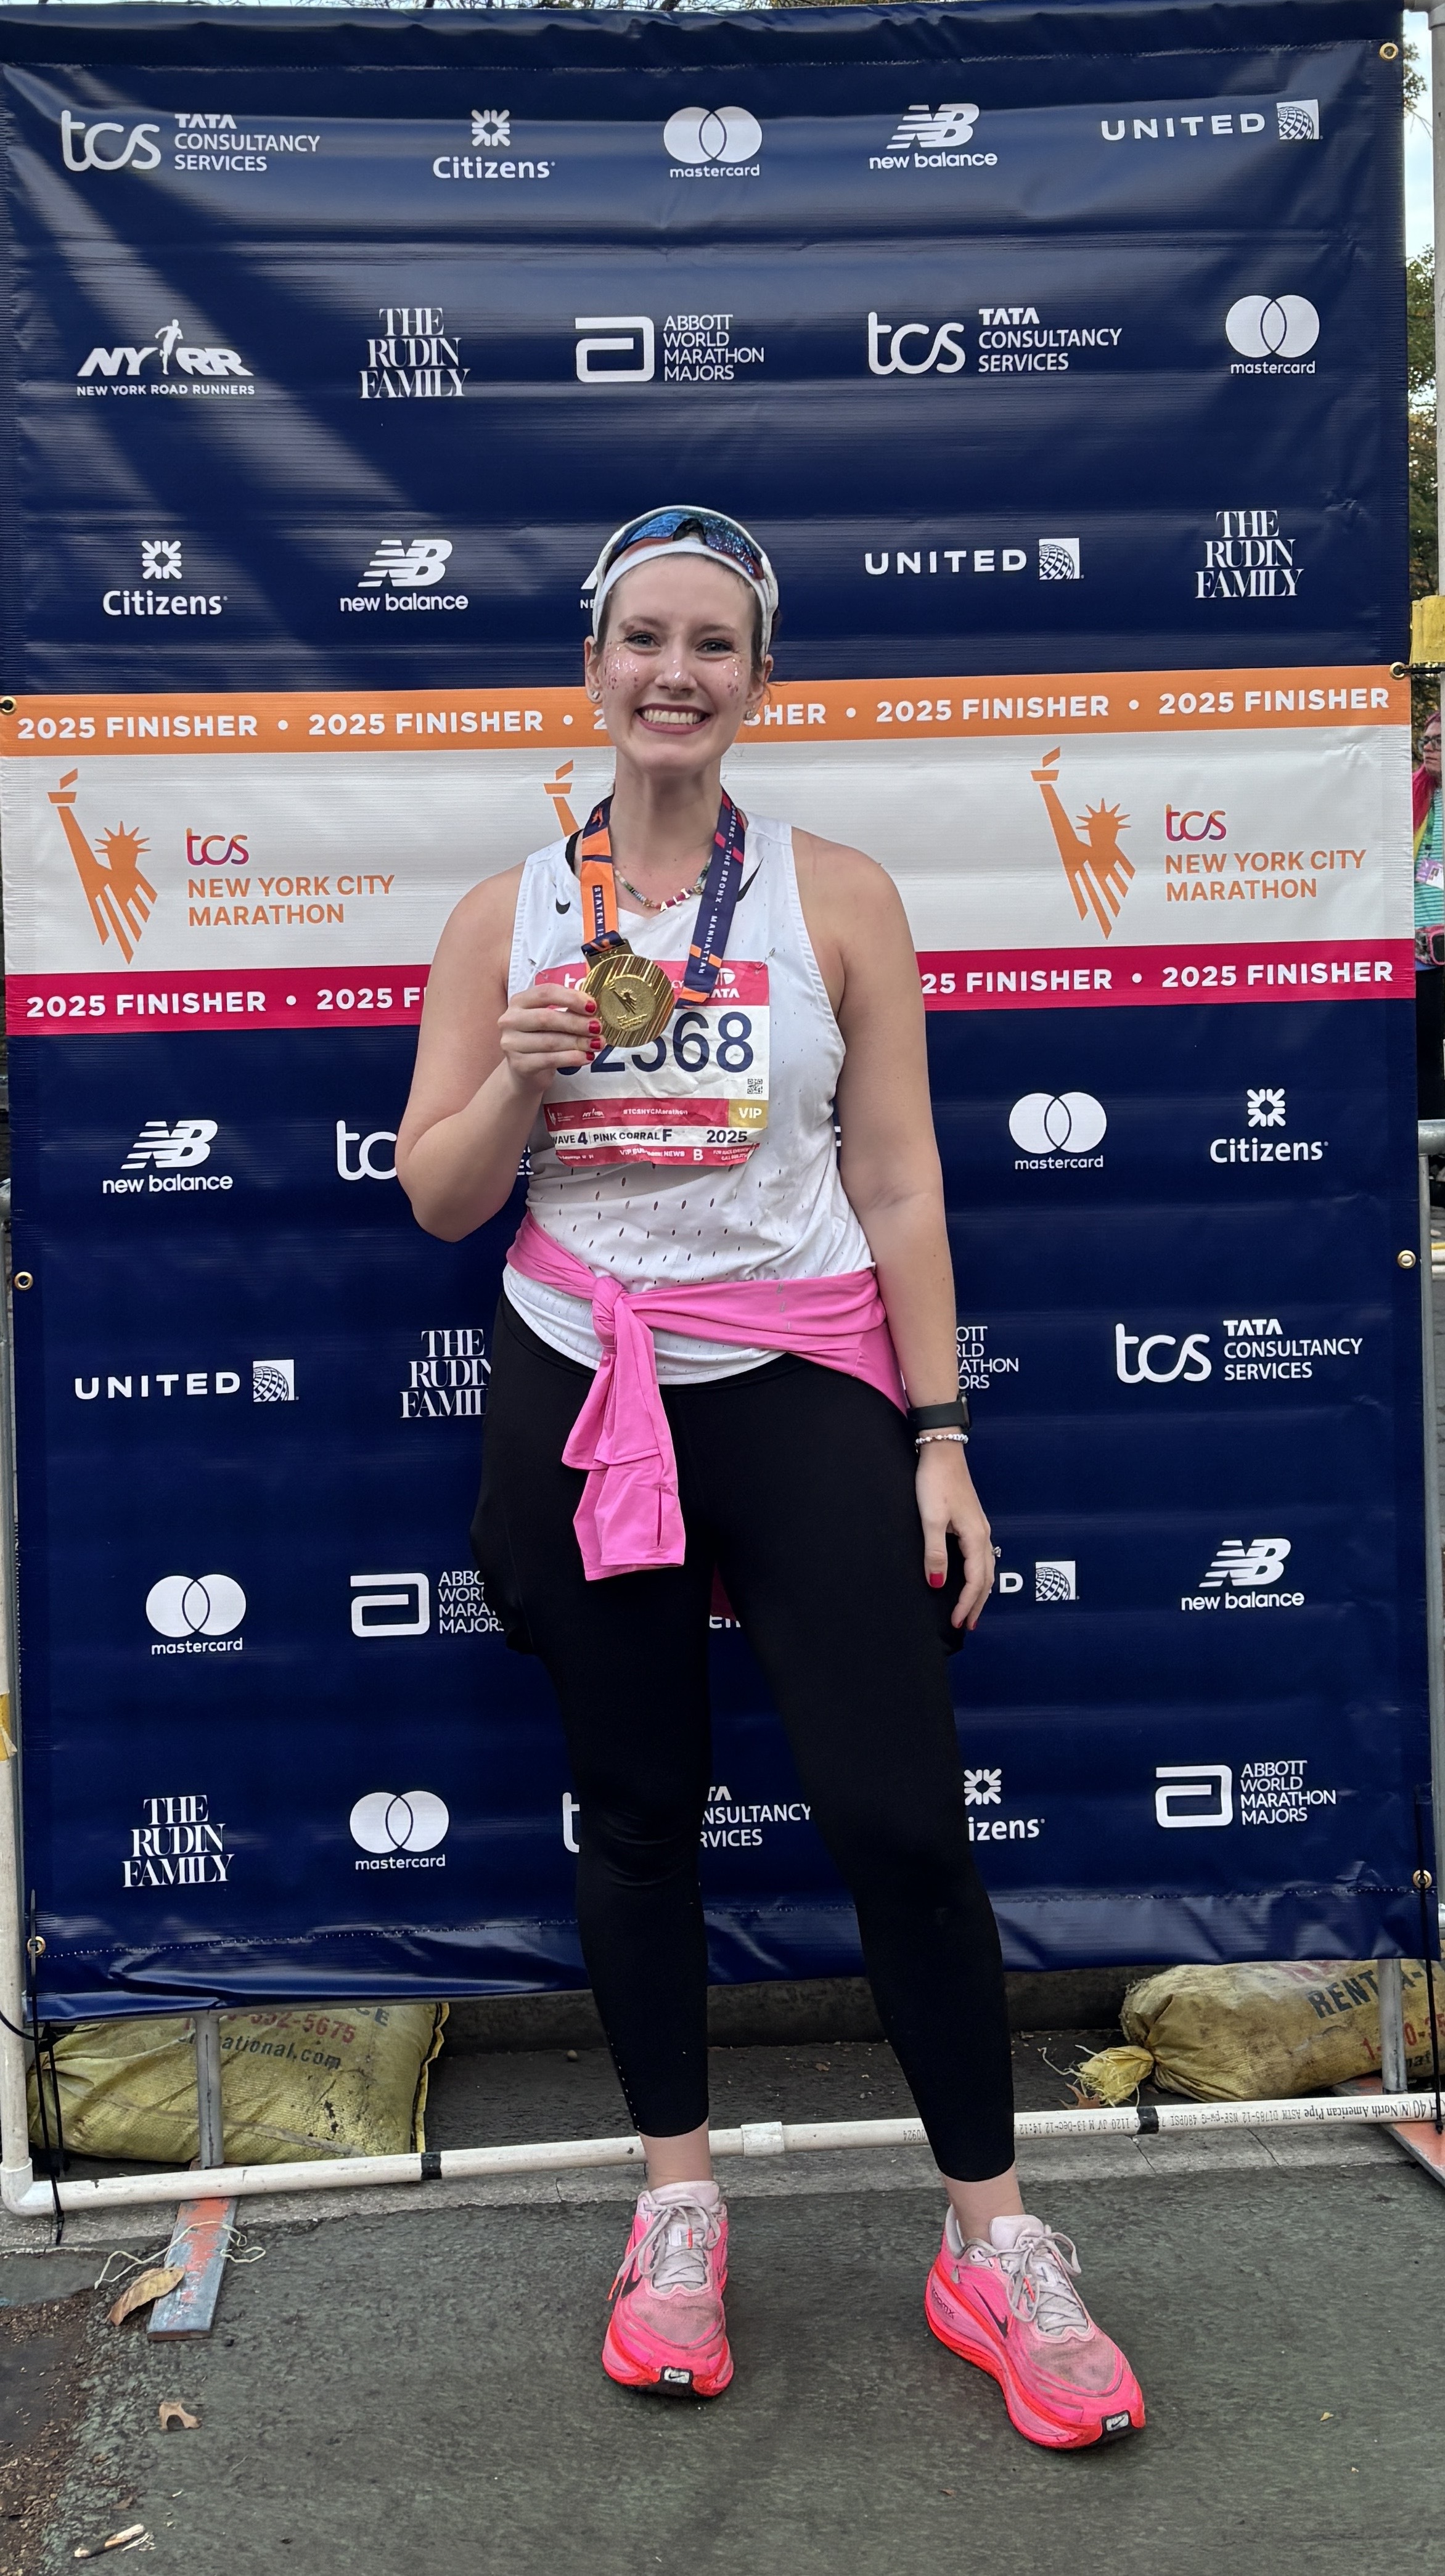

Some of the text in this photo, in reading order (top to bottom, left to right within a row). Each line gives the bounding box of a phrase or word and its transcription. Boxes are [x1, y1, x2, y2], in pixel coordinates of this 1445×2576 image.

[174, 114, 237, 129] TATA
[1102, 113, 1264, 140] UNITED
[62, 110, 161, 171] tcs
[174, 133, 320, 152] CONSULTANCY
[174, 155, 267, 171] SERVICES
[433, 157, 549, 178] Citizens
[869, 152, 997, 169] new balance
[670, 164, 759, 178] mastercard
[380, 308, 443, 336] THE
[664, 314, 733, 331] ABBOTT
[979, 308, 1039, 325] TATA
[663, 332, 729, 347] WORLD
[868, 312, 965, 374] tcs
[979, 329, 1122, 349] CONSULTANCY
[368, 338, 461, 367] RUDIN
[665, 348, 764, 364] MARATHON
[978, 353, 1068, 372] SERVICES
[1230, 361, 1315, 374] mastercard
[665, 365, 734, 381] MAJORS
[77, 385, 255, 396] NEW YORK ROAD RUNNERS
[361, 369, 470, 398] FAMILY
[1216, 510, 1279, 538] THE
[865, 550, 1026, 574] UNITED
[1205, 539, 1295, 568] RUDIN
[1196, 569, 1304, 598] FAMILY
[104, 591, 221, 615] Citizens
[340, 593, 468, 611] new balance
[877, 700, 951, 722] 2025
[964, 696, 1108, 719] FINISHER
[1159, 692, 1234, 714] 2025
[1245, 688, 1388, 711] FINISHER
[18, 711, 542, 738] 2025 FINISHER 2025 FINISHER
[1166, 805, 1226, 841] tcs
[187, 828, 248, 865] tcs
[722, 849, 732, 866] THE
[1166, 851, 1364, 873] NEW YORK CITY
[188, 875, 394, 898] NEW YORK CITY
[714, 869, 729, 904] BRONX
[1167, 880, 1316, 901] MARATHON
[594, 886, 604, 924] STATEN
[189, 904, 343, 926] MARATHON
[697, 915, 719, 975] MANHATTAN
[921, 962, 1393, 995] 25 FINISHER 2025 FINISHER
[27, 996, 105, 1017] 2025
[117, 992, 266, 1015] FINISHER
[317, 988, 392, 1010] 2025
[711, 988, 740, 998] ATA
[739, 1107, 763, 1119] VIP
[577, 1131, 588, 1145] 4
[594, 1132, 616, 1143] PINK
[619, 1131, 660, 1142] CORRAL
[663, 1129, 673, 1142] F
[706, 1129, 748, 1144] 2025
[693, 1148, 704, 1161] B
[1210, 1138, 1322, 1163] Citizens
[1015, 1155, 1103, 1169] mastercard
[103, 1174, 232, 1193] new balance
[956, 1326, 988, 1342] OTT
[1223, 1319, 1282, 1336] TATA
[422, 1329, 484, 1357] THE
[956, 1343, 984, 1357] RLD
[1224, 1338, 1362, 1359] CONSULTANCY
[1116, 1323, 1211, 1383] tcs
[959, 1357, 1018, 1373] ATHON
[1225, 1362, 1312, 1380] SERVICES
[75, 1372, 240, 1399] UNITED
[958, 1374, 990, 1389] ORS
[399, 1388, 488, 1418] FAMIL
[439, 1602, 496, 1618] MARA
[1182, 1592, 1304, 1610] new balance
[152, 1637, 242, 1654] mastercard
[1242, 1760, 1307, 1778] ABBOTT
[1240, 1777, 1303, 1792] WORLD
[1241, 1790, 1336, 1809] MARATHON
[144, 1795, 208, 1825] THE
[702, 1803, 811, 1825] NSULTANCY
[1242, 1807, 1307, 1825] MAJORS
[700, 1828, 763, 1848] RVICES
[968, 1817, 1039, 1841] izens
[131, 1823, 226, 1857] RUDIN
[123, 1854, 235, 1887] FAMILY
[356, 1854, 445, 1870] mastercard
[1282, 2109, 1301, 2120] ASTM
[1304, 2105, 1324, 2120] Pipe
[1326, 2106, 1369, 2119] American
[1372, 2104, 1398, 2117] North
[1112, 2118, 1129, 2130] 1120
